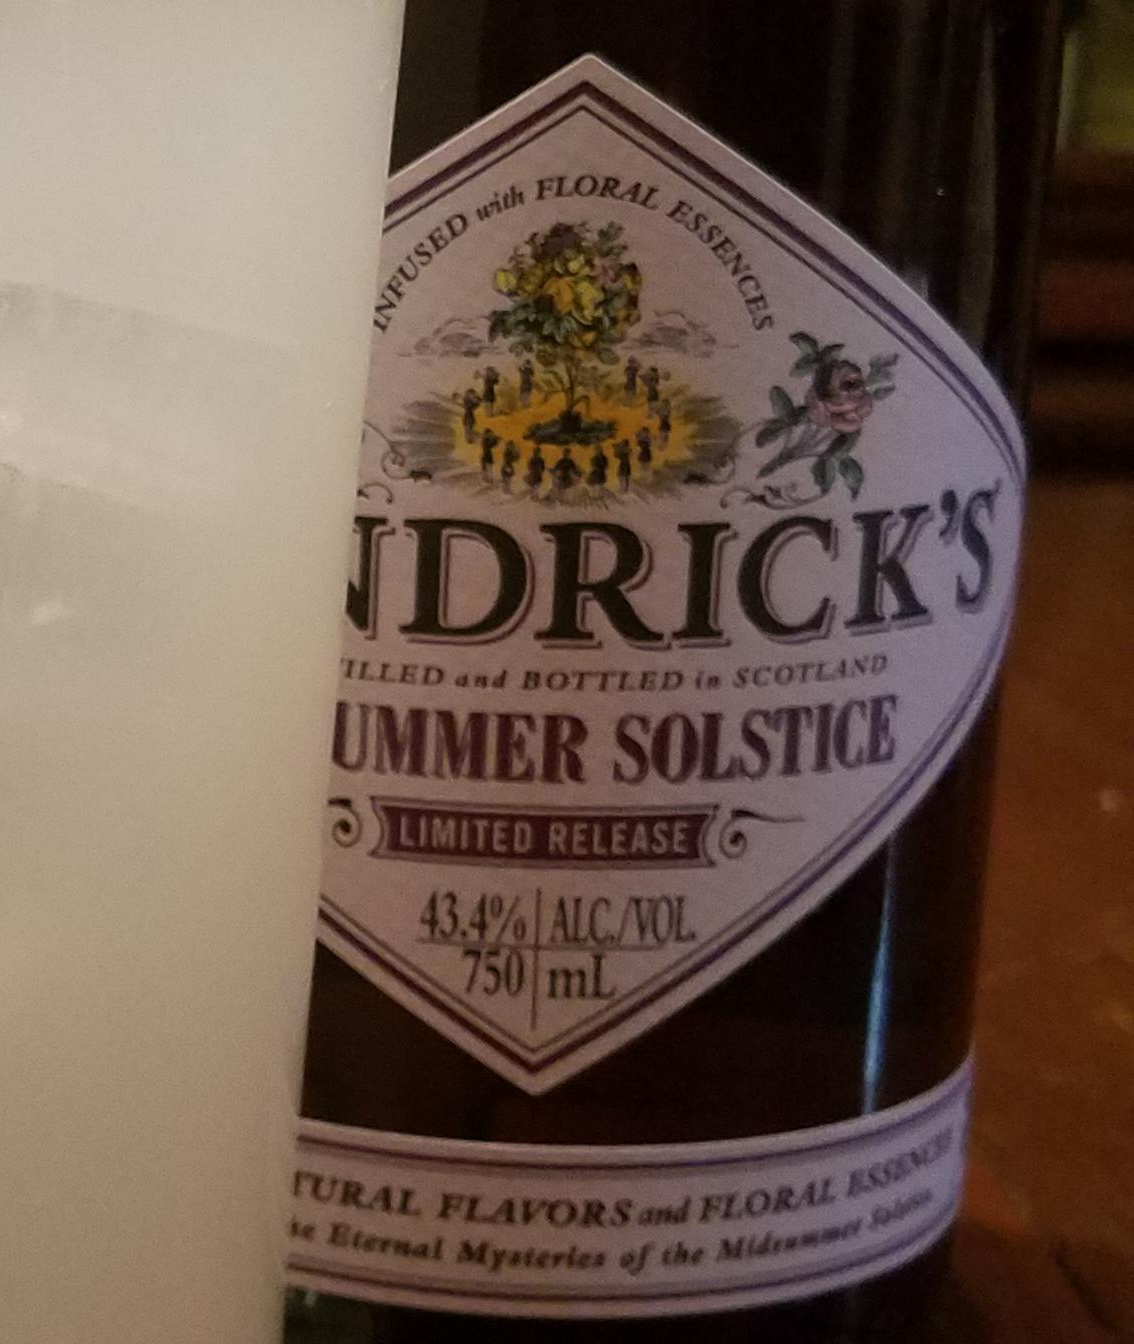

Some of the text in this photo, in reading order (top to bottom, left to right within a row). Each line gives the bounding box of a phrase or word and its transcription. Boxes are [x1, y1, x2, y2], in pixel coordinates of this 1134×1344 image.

[373, 174, 776, 334] INFUSED with FLORAL ESSENCES
[341, 654, 889, 693] ILLED and BOTTLED in SCOTLAND
[332, 693, 899, 786] UMMER SOLSTICE
[399, 814, 690, 856] LIMITED RELEASE
[420, 890, 527, 943] 43.4%
[462, 949, 615, 1000] 750 mL
[436, 1192, 633, 1229] FLAVORS
[638, 1195, 692, 1227] and
[699, 1178, 836, 1223] FLORAL
[328, 1221, 443, 1261] Eternal
[456, 1239, 606, 1273] Mysteries
[619, 1241, 656, 1276] of
[663, 1241, 704, 1266] the
[719, 1218, 864, 1258] Midsummer
